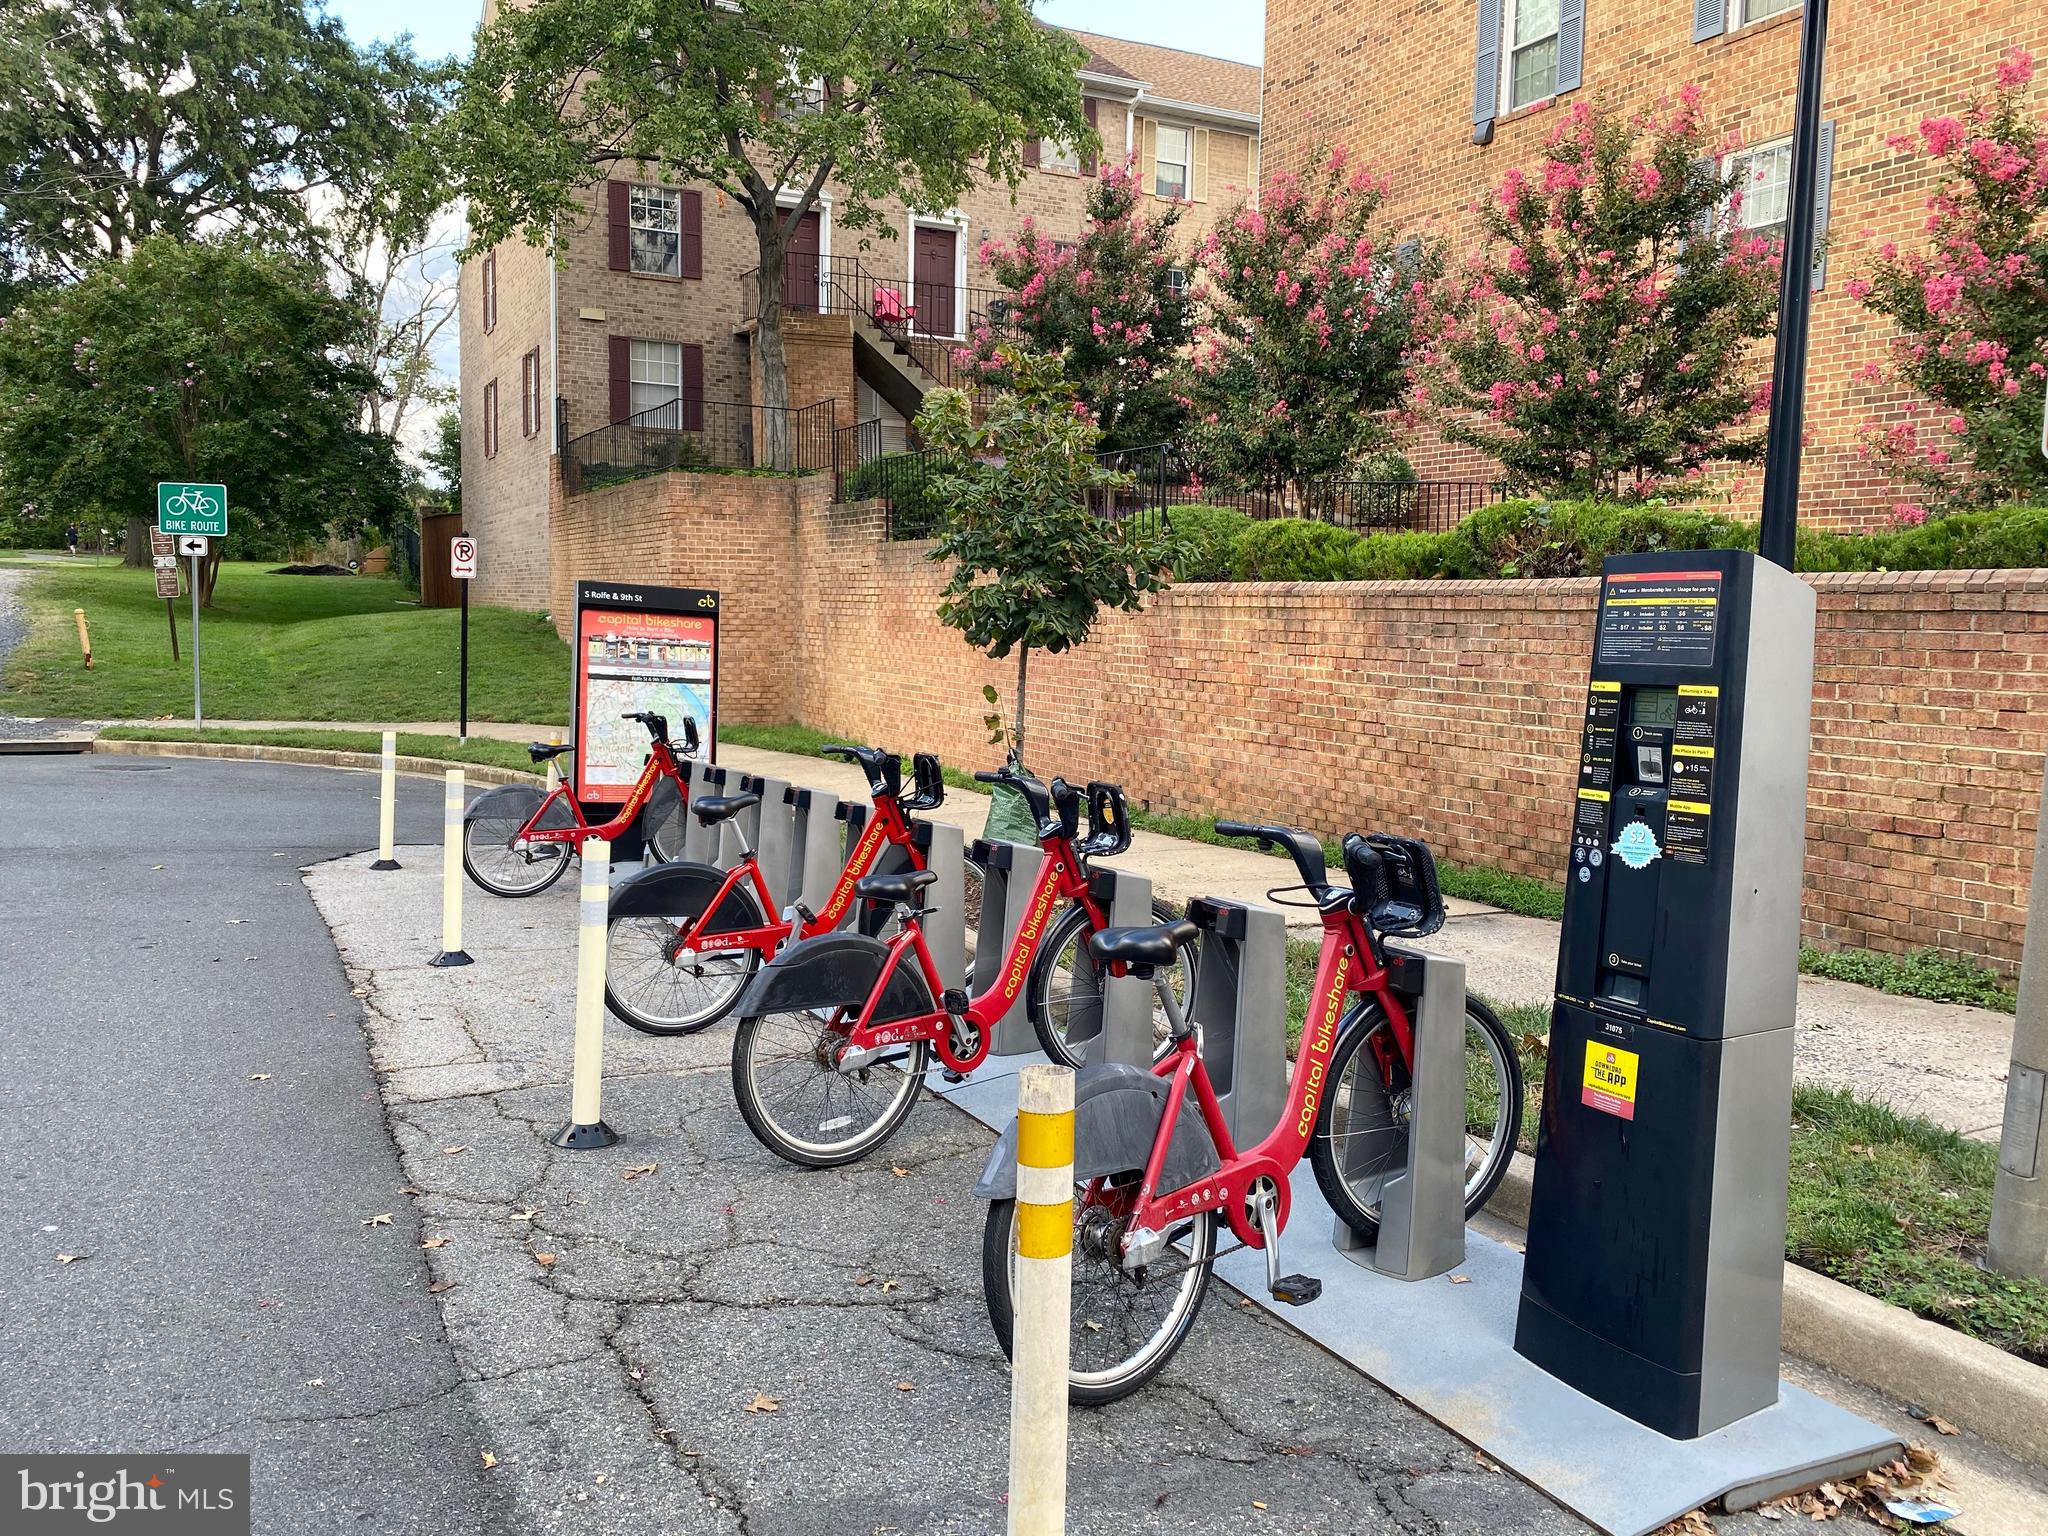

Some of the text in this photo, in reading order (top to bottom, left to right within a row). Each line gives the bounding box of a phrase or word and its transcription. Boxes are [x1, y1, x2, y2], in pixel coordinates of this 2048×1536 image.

[166, 520, 220, 532] BIKE ROUTE
[592, 592, 610, 600] Rolfe
[598, 614, 703, 630] capital bikeshare
[620, 793, 639, 824] capital
[634, 759, 660, 795] bikeshare
[1631, 829, 1646, 844] $2
[828, 822, 884, 920] capital bikeshare
[1004, 871, 1058, 1000] capital bikeshare
[1605, 1023, 1622, 1034] 31075
[1297, 957, 1348, 1138] capital bikeshare
[1594, 1060, 1622, 1074] DOWNLOAD
[1608, 1072, 1626, 1088] APP
